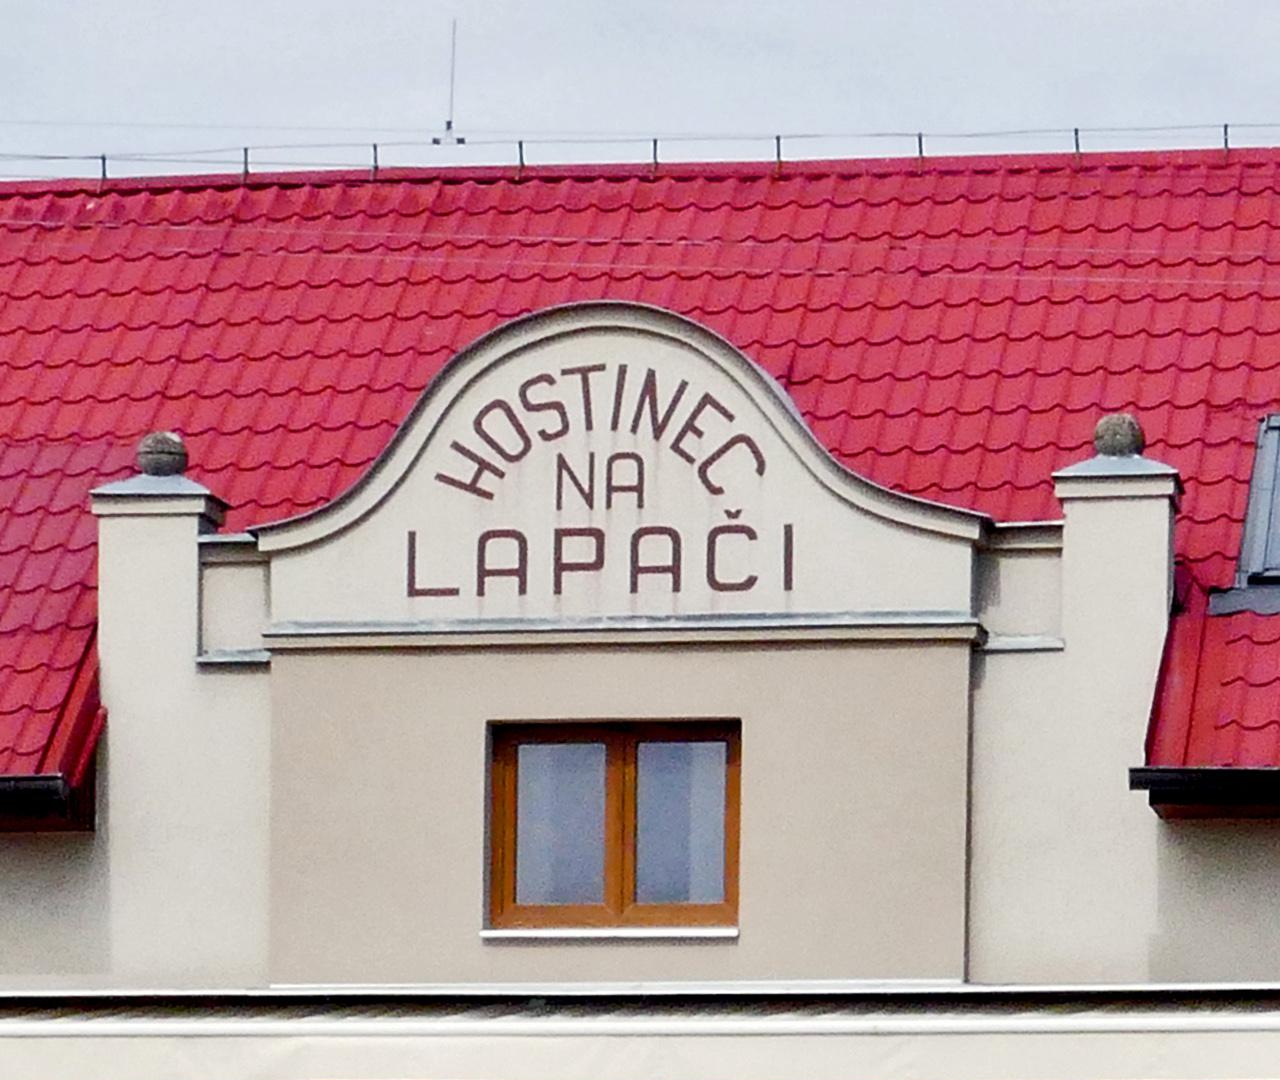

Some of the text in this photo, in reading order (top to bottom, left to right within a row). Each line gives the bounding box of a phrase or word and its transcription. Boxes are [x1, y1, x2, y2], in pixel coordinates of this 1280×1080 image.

[434, 363, 767, 500] HOSTINEC
[556, 451, 645, 510] NA
[407, 509, 794, 597] LAPAČI
